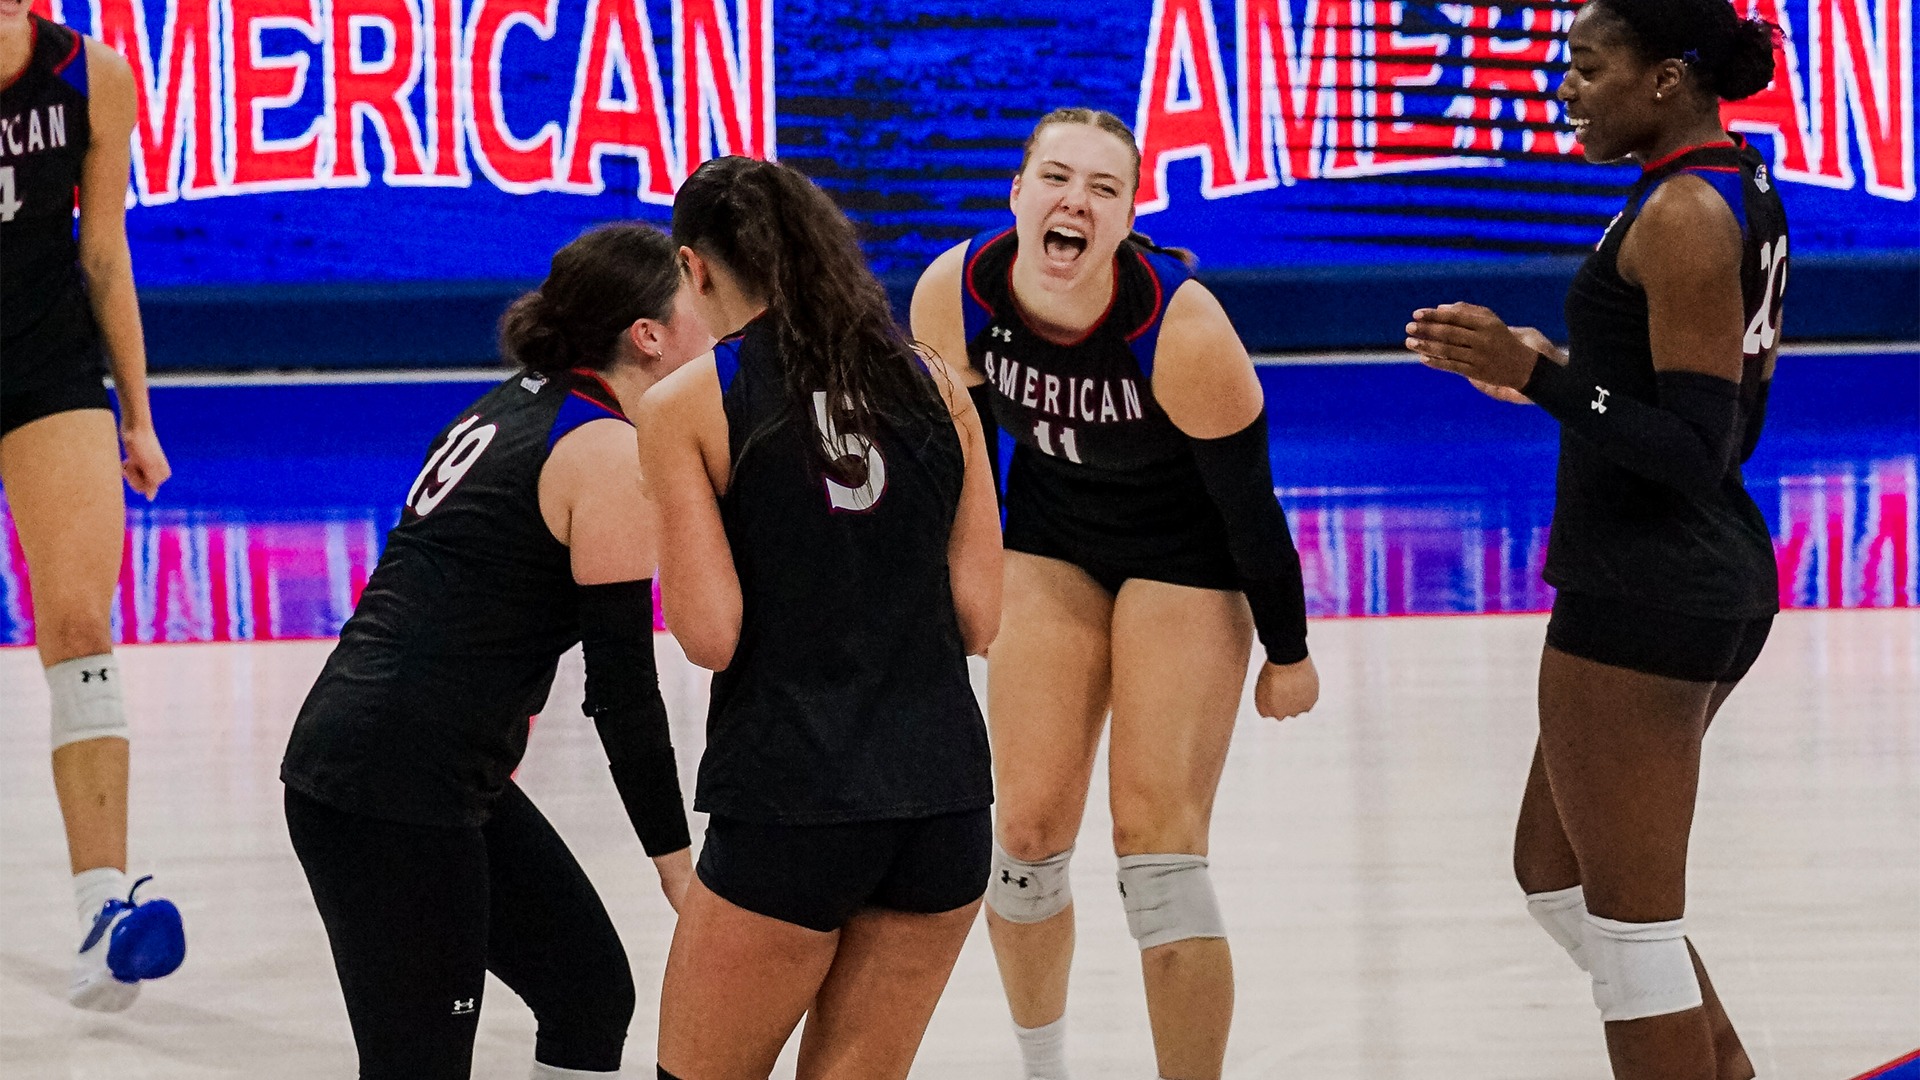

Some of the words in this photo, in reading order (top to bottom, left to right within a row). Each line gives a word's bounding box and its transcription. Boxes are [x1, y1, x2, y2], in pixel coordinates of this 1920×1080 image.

[30, 0, 777, 207] MERICAN
[984, 350, 1142, 423] AMERICAN
[406, 414, 497, 516] 19
[812, 390, 886, 511] 5
[1033, 420, 1083, 464] 11
